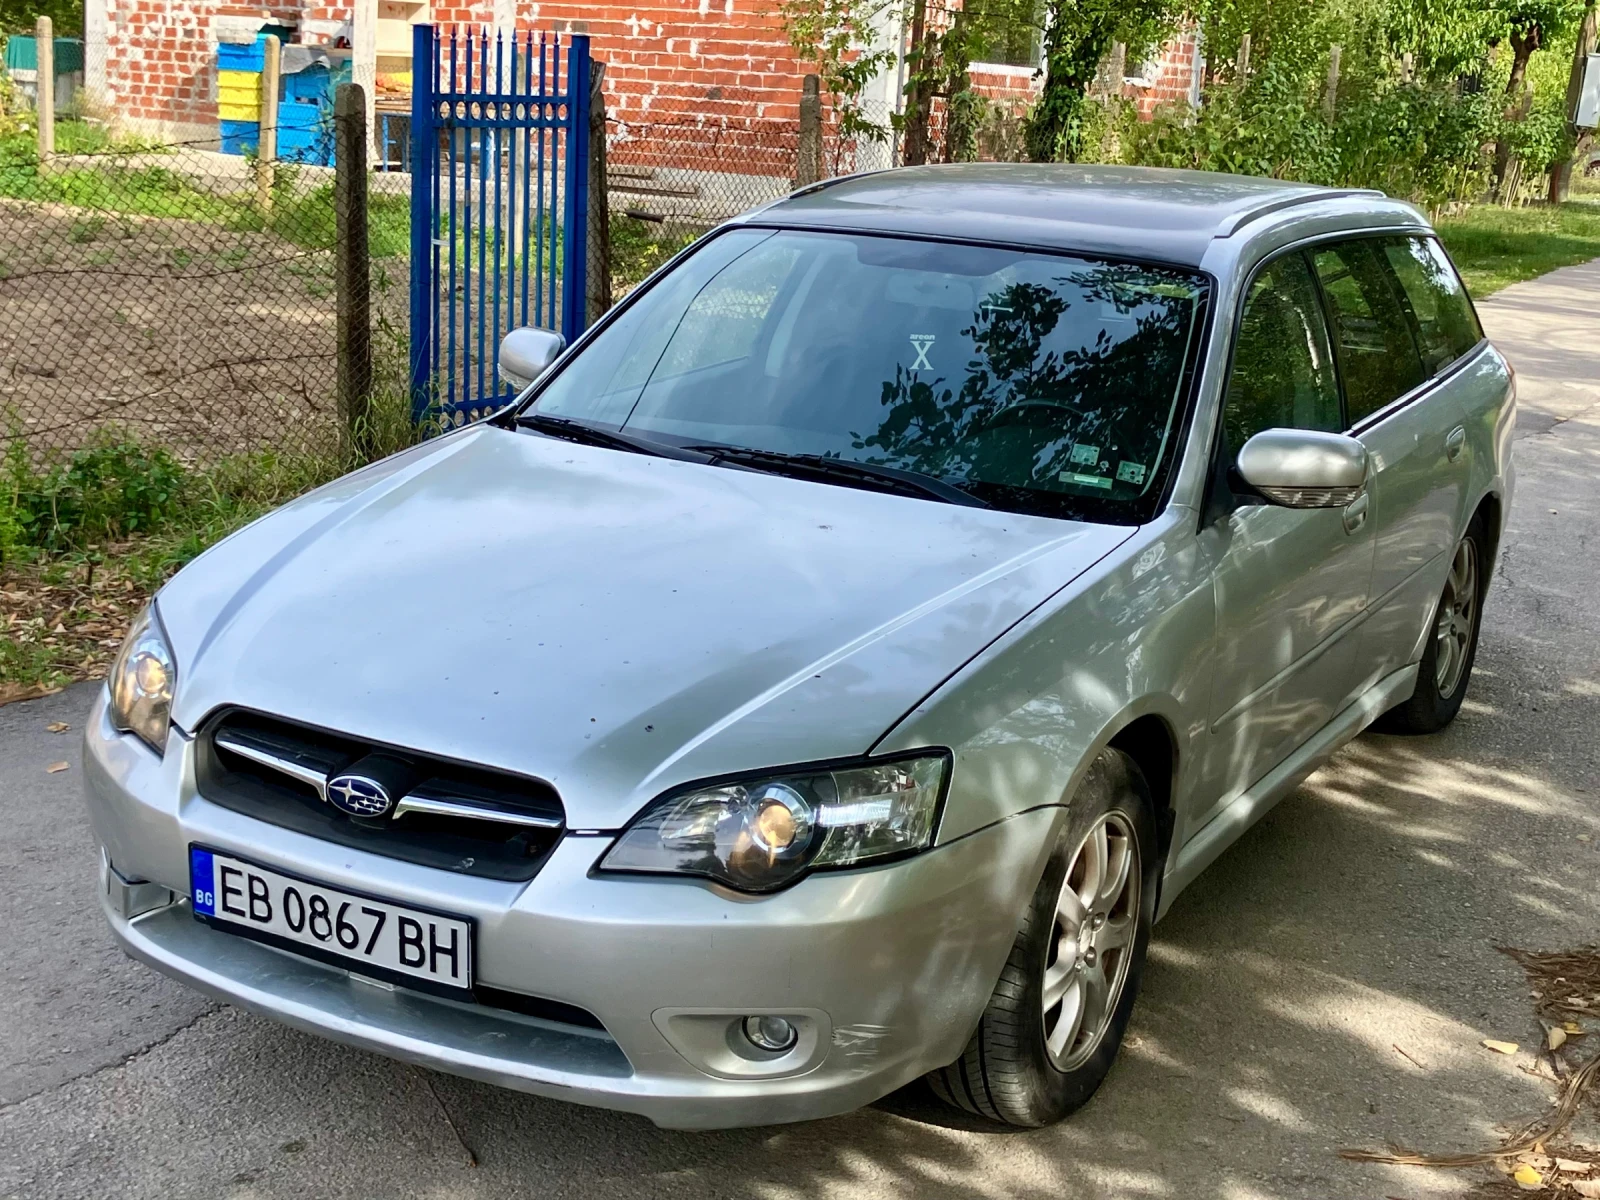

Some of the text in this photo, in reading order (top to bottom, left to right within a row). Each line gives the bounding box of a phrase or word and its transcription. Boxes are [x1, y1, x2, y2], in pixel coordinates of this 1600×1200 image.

[909, 340, 936, 370] X
[195, 888, 213, 907] BG
[220, 865, 459, 978] EB 0867 BH
